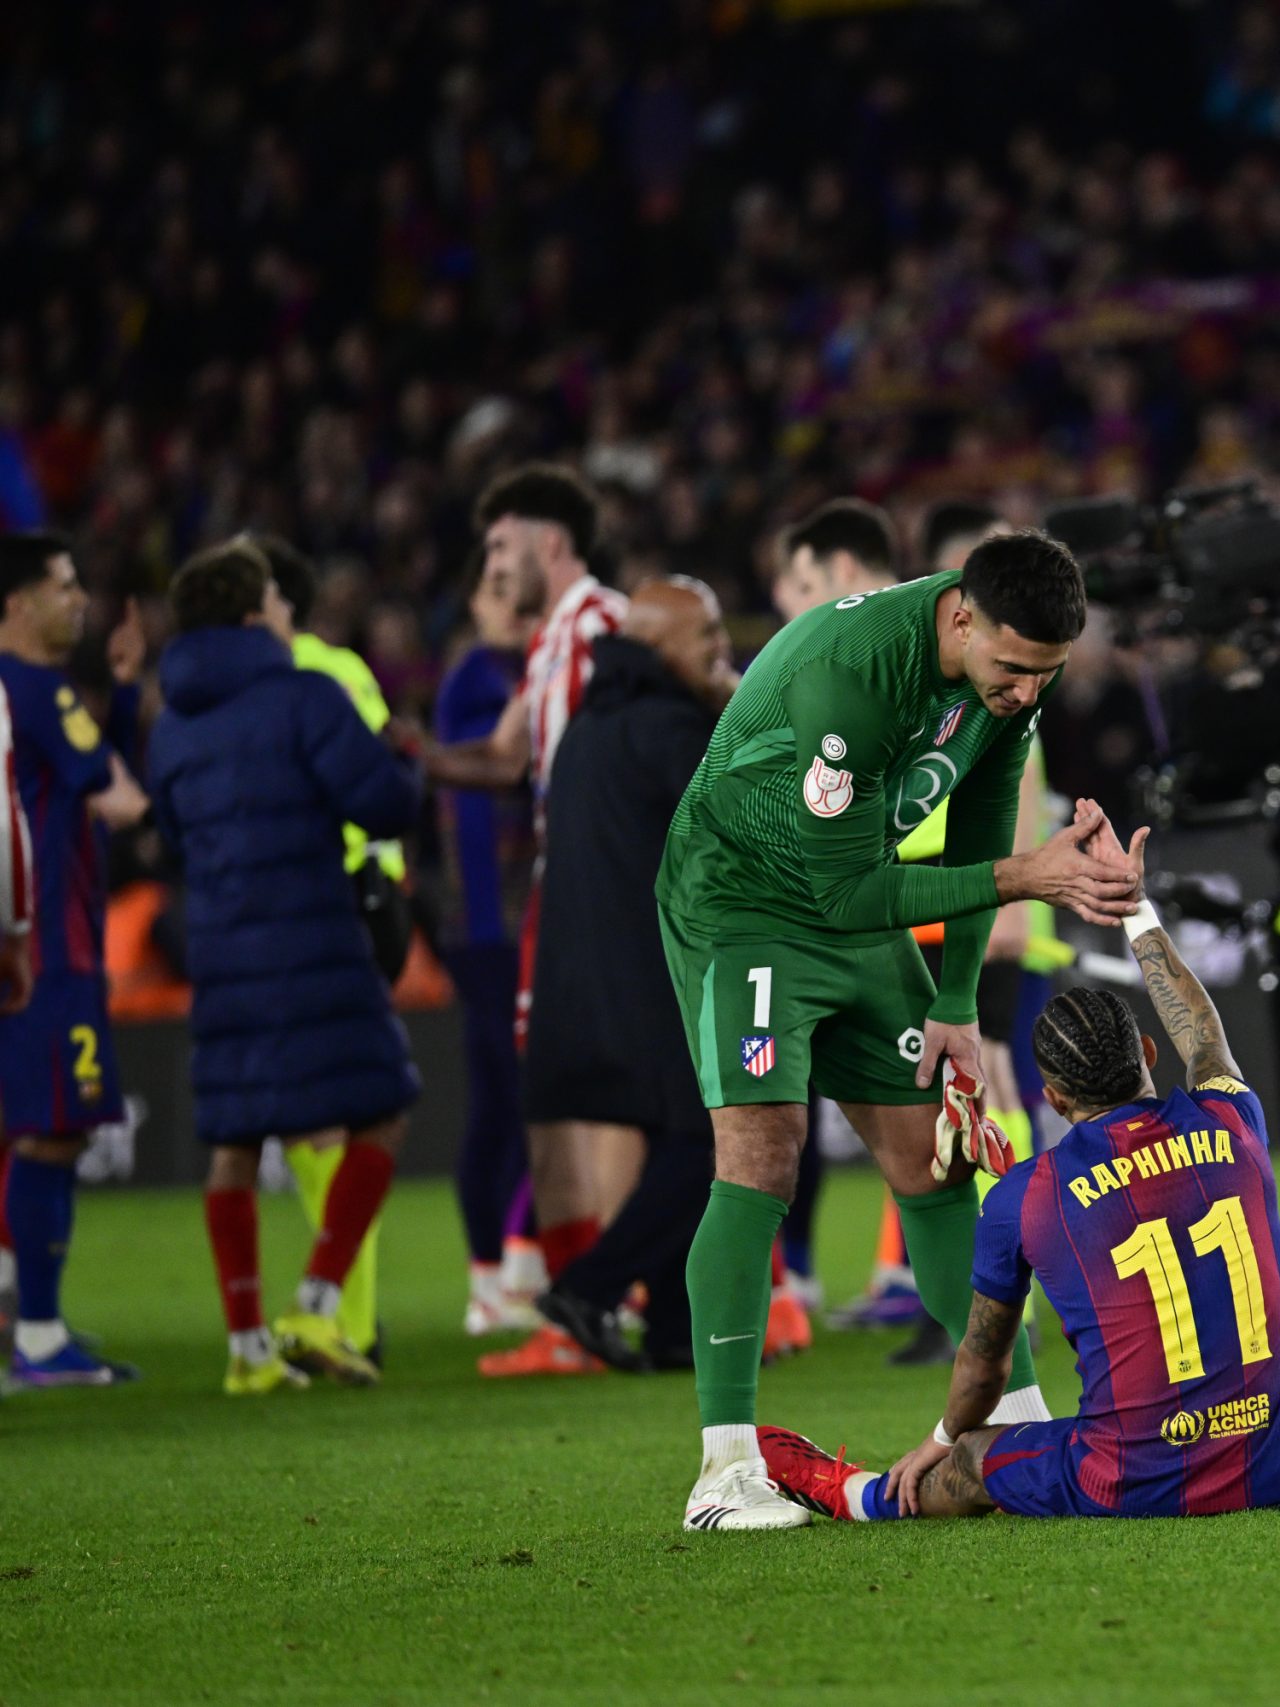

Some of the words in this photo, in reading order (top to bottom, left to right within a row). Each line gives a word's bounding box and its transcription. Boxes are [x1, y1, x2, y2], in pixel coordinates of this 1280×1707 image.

[827, 741, 841, 753] 10
[747, 966, 772, 1029] 1
[69, 1024, 101, 1081] 2
[1068, 1129, 1235, 1208] RAPHINHA
[1110, 1196, 1273, 1384] 11
[1207, 1393, 1270, 1419] UNHCR
[1208, 1408, 1270, 1433] ACNUR
